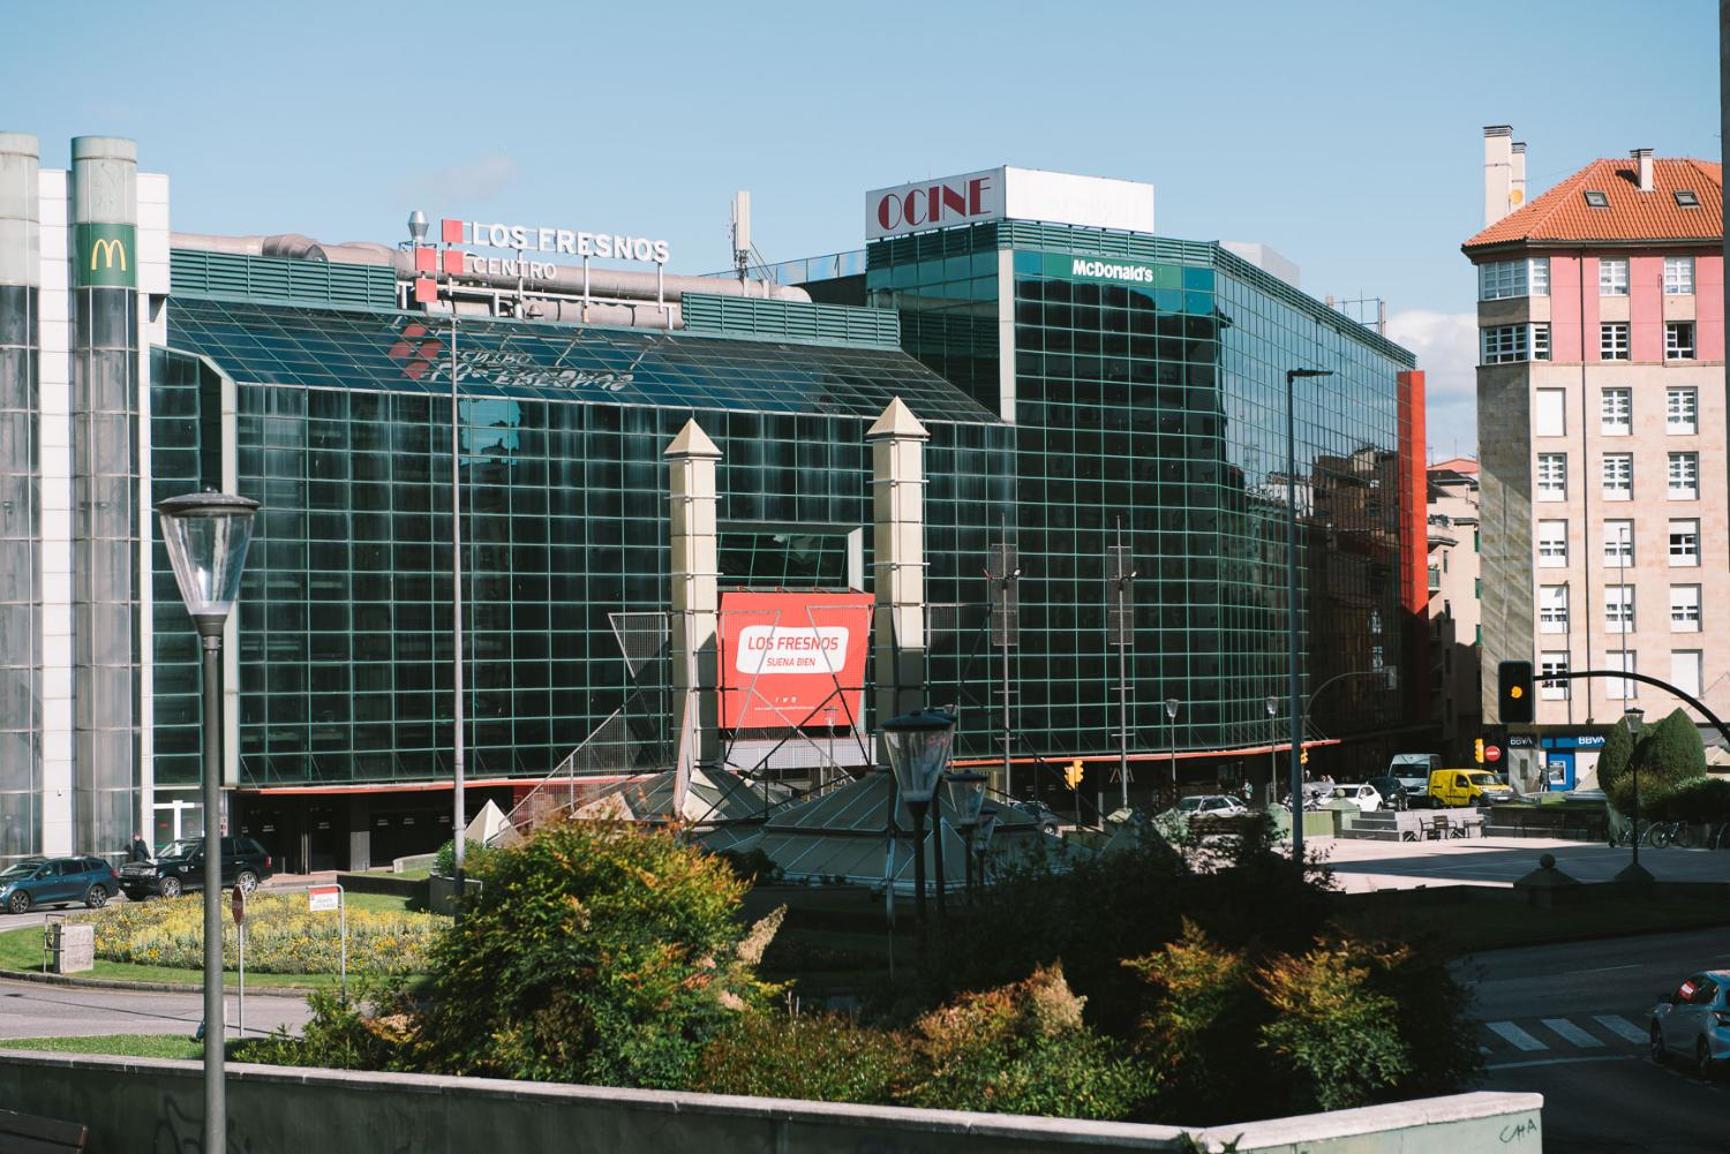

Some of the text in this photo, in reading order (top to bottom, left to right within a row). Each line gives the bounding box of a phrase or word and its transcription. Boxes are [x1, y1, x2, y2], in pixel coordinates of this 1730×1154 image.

[878, 176, 992, 231] OCINE
[472, 221, 670, 264] LOS FRESNOS
[472, 256, 557, 280] CENTRO
[1072, 259, 1153, 283] McDonald's
[748, 636, 839, 651] LOS FRESNOS
[767, 657, 816, 667] SUENA BIEN
[1510, 736, 1533, 746] BBVA
[1578, 736, 1606, 745] BBVA
